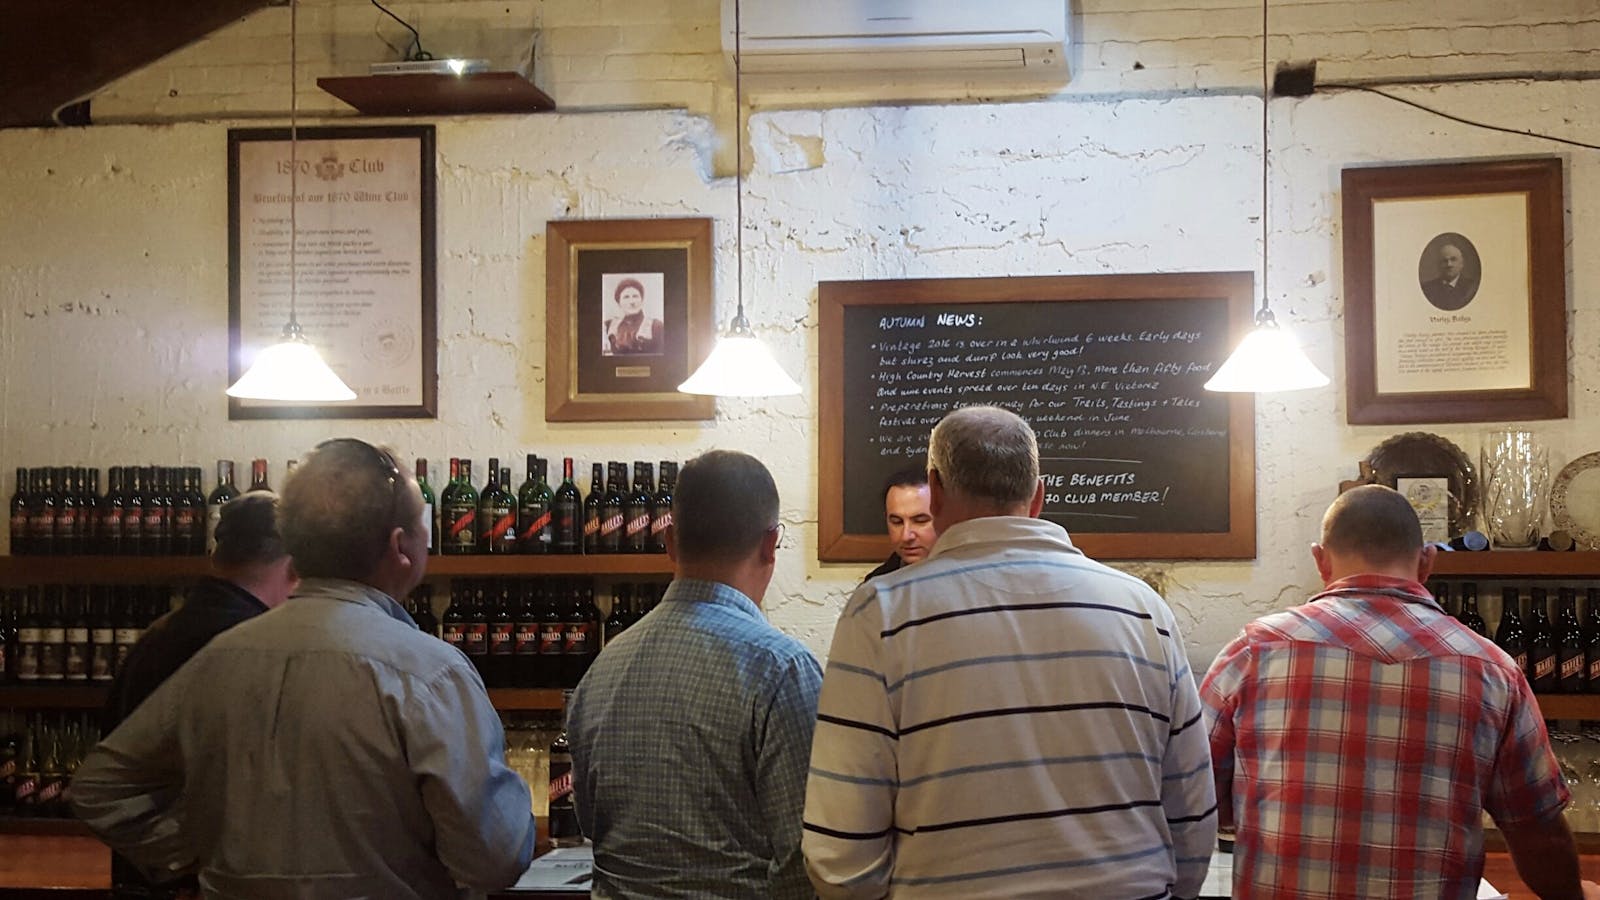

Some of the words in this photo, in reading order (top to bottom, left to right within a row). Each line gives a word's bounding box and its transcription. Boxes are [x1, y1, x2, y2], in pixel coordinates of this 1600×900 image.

[276, 160, 310, 174] 1870
[350, 158, 384, 174] Club
[328, 192, 350, 204] 1870
[879, 316, 926, 330] AUTUMN
[936, 313, 984, 328] NEWS:
[879, 340, 921, 354] Vintage
[928, 339, 950, 349] 2016
[955, 339, 965, 348] is
[970, 339, 993, 348] over
[995, 338, 1008, 348] in
[1010, 338, 1018, 347] a
[1022, 334, 1079, 346] whirlwind
[1085, 332, 1094, 343] 6
[1138, 331, 1170, 344] Early
[1172, 330, 1201, 344] days
[879, 356, 897, 366] but
[938, 353, 960, 364] and
[1001, 350, 1022, 360] look
[1028, 350, 1050, 362] very
[1052, 346, 1085, 360] good!
[878, 371, 902, 384] High
[906, 370, 944, 382] Country
[946, 368, 987, 380] Harvest
[990, 366, 1043, 376] commences
[1048, 364, 1074, 379] May
[1122, 362, 1149, 375] than
[1153, 361, 1182, 376] fifty
[1185, 361, 1212, 375] food
[876, 387, 896, 397] and
[922, 385, 953, 394] events
[958, 382, 993, 396] spread
[998, 384, 1018, 392] over
[1022, 382, 1038, 391] ten
[1042, 381, 1068, 394] days
[1074, 382, 1085, 390] in
[1114, 381, 1160, 390] Victoria
[880, 402, 948, 415] Preparations
[952, 401, 968, 410] are
[1028, 398, 1044, 408] for
[1072, 396, 1108, 410] Trails,
[1112, 397, 1157, 412] Tastings
[1172, 396, 1200, 408] Tales
[880, 416, 916, 428] festival
[920, 416, 942, 425] over
[1036, 413, 1084, 422] weekend
[1104, 414, 1130, 422] June
[1044, 428, 1068, 438] Club
[1074, 428, 1111, 437] dinners
[1114, 428, 1125, 436] in
[880, 447, 900, 456] and
[1058, 441, 1088, 450] now!
[1040, 474, 1064, 487] THE
[1070, 473, 1136, 487] BENEFITS
[1064, 493, 1097, 504] CLUB
[1100, 486, 1171, 506] MEMBER!
